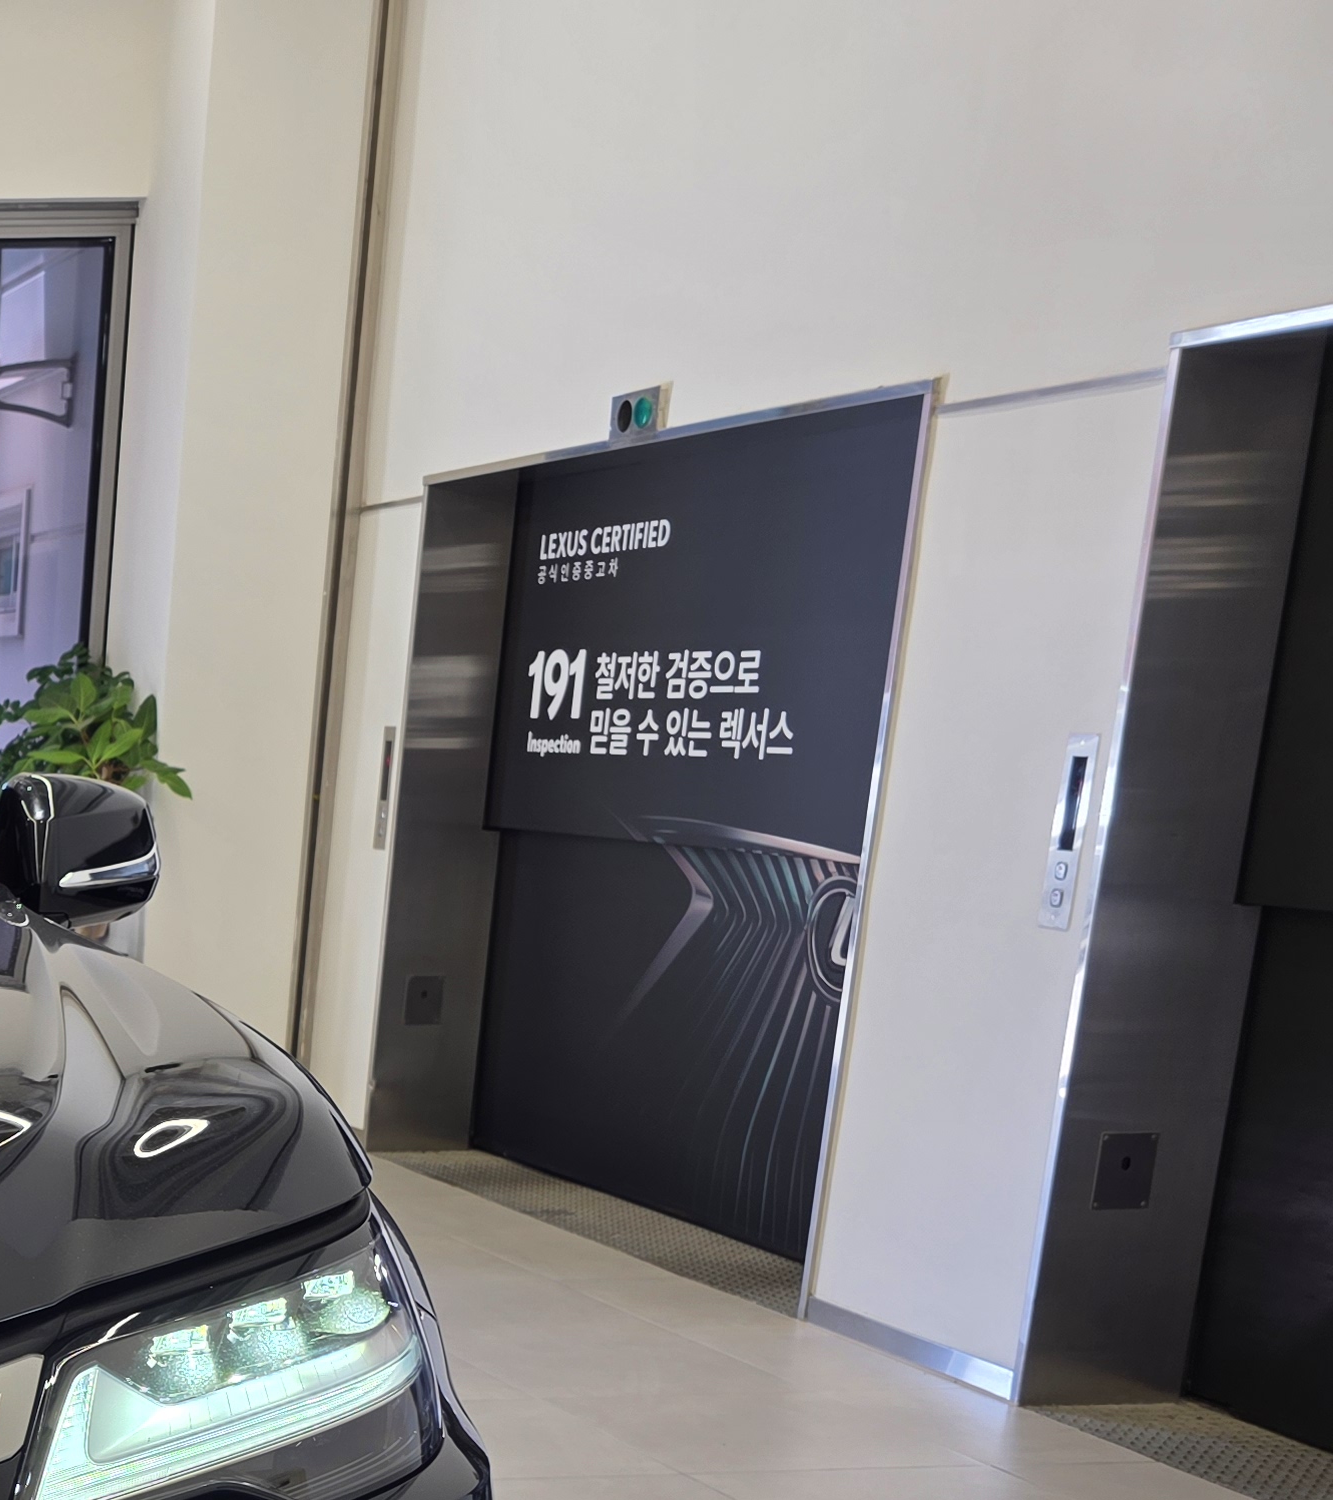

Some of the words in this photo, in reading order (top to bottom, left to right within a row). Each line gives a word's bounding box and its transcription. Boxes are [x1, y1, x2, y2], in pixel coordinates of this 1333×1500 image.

[539, 529, 589, 560] LEXUS
[590, 519, 671, 555] CERTIFIED
[528, 648, 587, 721] 191
[595, 650, 661, 700] 철저한
[665, 649, 762, 700] 검증으로
[527, 730, 581, 757] Inspection
[589, 707, 632, 756] 믿을
[636, 708, 660, 756] 수
[664, 707, 712, 757] 있는
[719, 707, 794, 760] 렉서스
